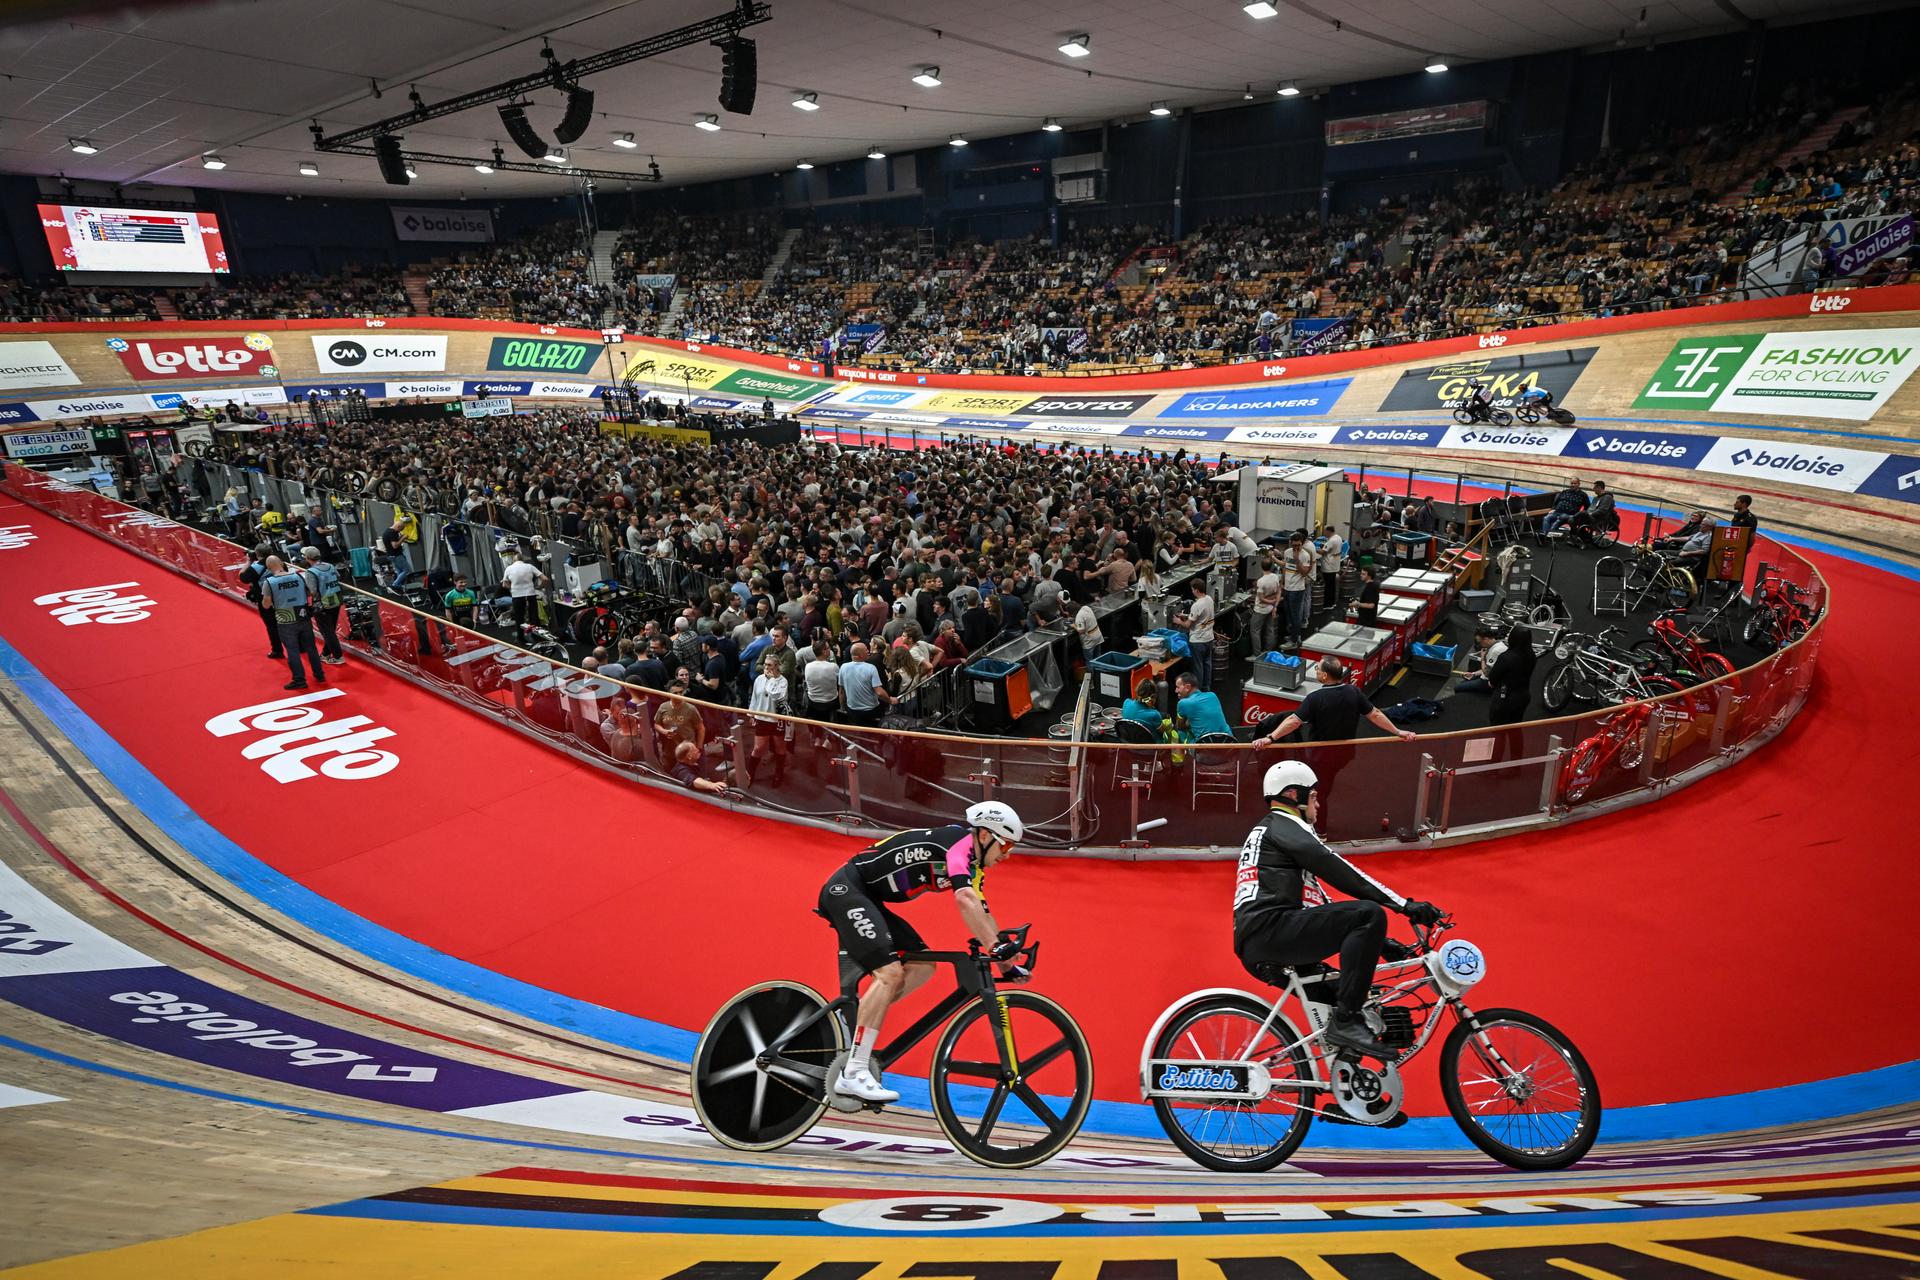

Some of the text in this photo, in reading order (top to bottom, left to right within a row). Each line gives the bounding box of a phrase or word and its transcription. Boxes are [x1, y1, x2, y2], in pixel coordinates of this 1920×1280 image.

[43, 219, 66, 228] lotto
[422, 216, 486, 232] baloise
[1851, 216, 1902, 244] av
[1855, 223, 1911, 264] baloise
[640, 276, 672, 286] radio2
[1810, 295, 1850, 312] lotto
[1479, 335, 1507, 347] lotto
[136, 343, 253, 374] lotto
[331, 349, 359, 359] CM
[373, 348, 436, 358] CM.com
[503, 341, 587, 369] GOLAZO
[1760, 347, 1913, 366] FASHION
[1263, 365, 1286, 376] lotto
[1452, 368, 1483, 376] Catering
[1747, 370, 1890, 384] FOR CYCLING
[411, 385, 451, 393] baloise
[485, 384, 521, 392] baloise
[1438, 371, 1539, 400] GEKA
[71, 401, 125, 412] baloise
[1217, 398, 1319, 410] BADKAMERS
[10, 432, 87, 445] DE GENTENAAR
[1157, 428, 1207, 436] baloise
[1261, 430, 1317, 439] baloise
[1364, 429, 1429, 441] baloise
[1479, 432, 1549, 446] baloise
[15, 442, 89, 456] radio2 avs
[1606, 438, 1687, 458] baloise
[1752, 451, 1845, 476] baloise
[1256, 496, 1305, 507] VERKINDERE
[279, 580, 299, 590] PRESS
[32, 581, 158, 626] lotto
[205, 687, 400, 784] lotto
[905, 847, 932, 864] lotto
[847, 907, 877, 939] lotto
[109, 991, 374, 1067] baloise
[1159, 1065, 1240, 1091] Estitch
[881, 1190, 1763, 1222] SUPER 8
